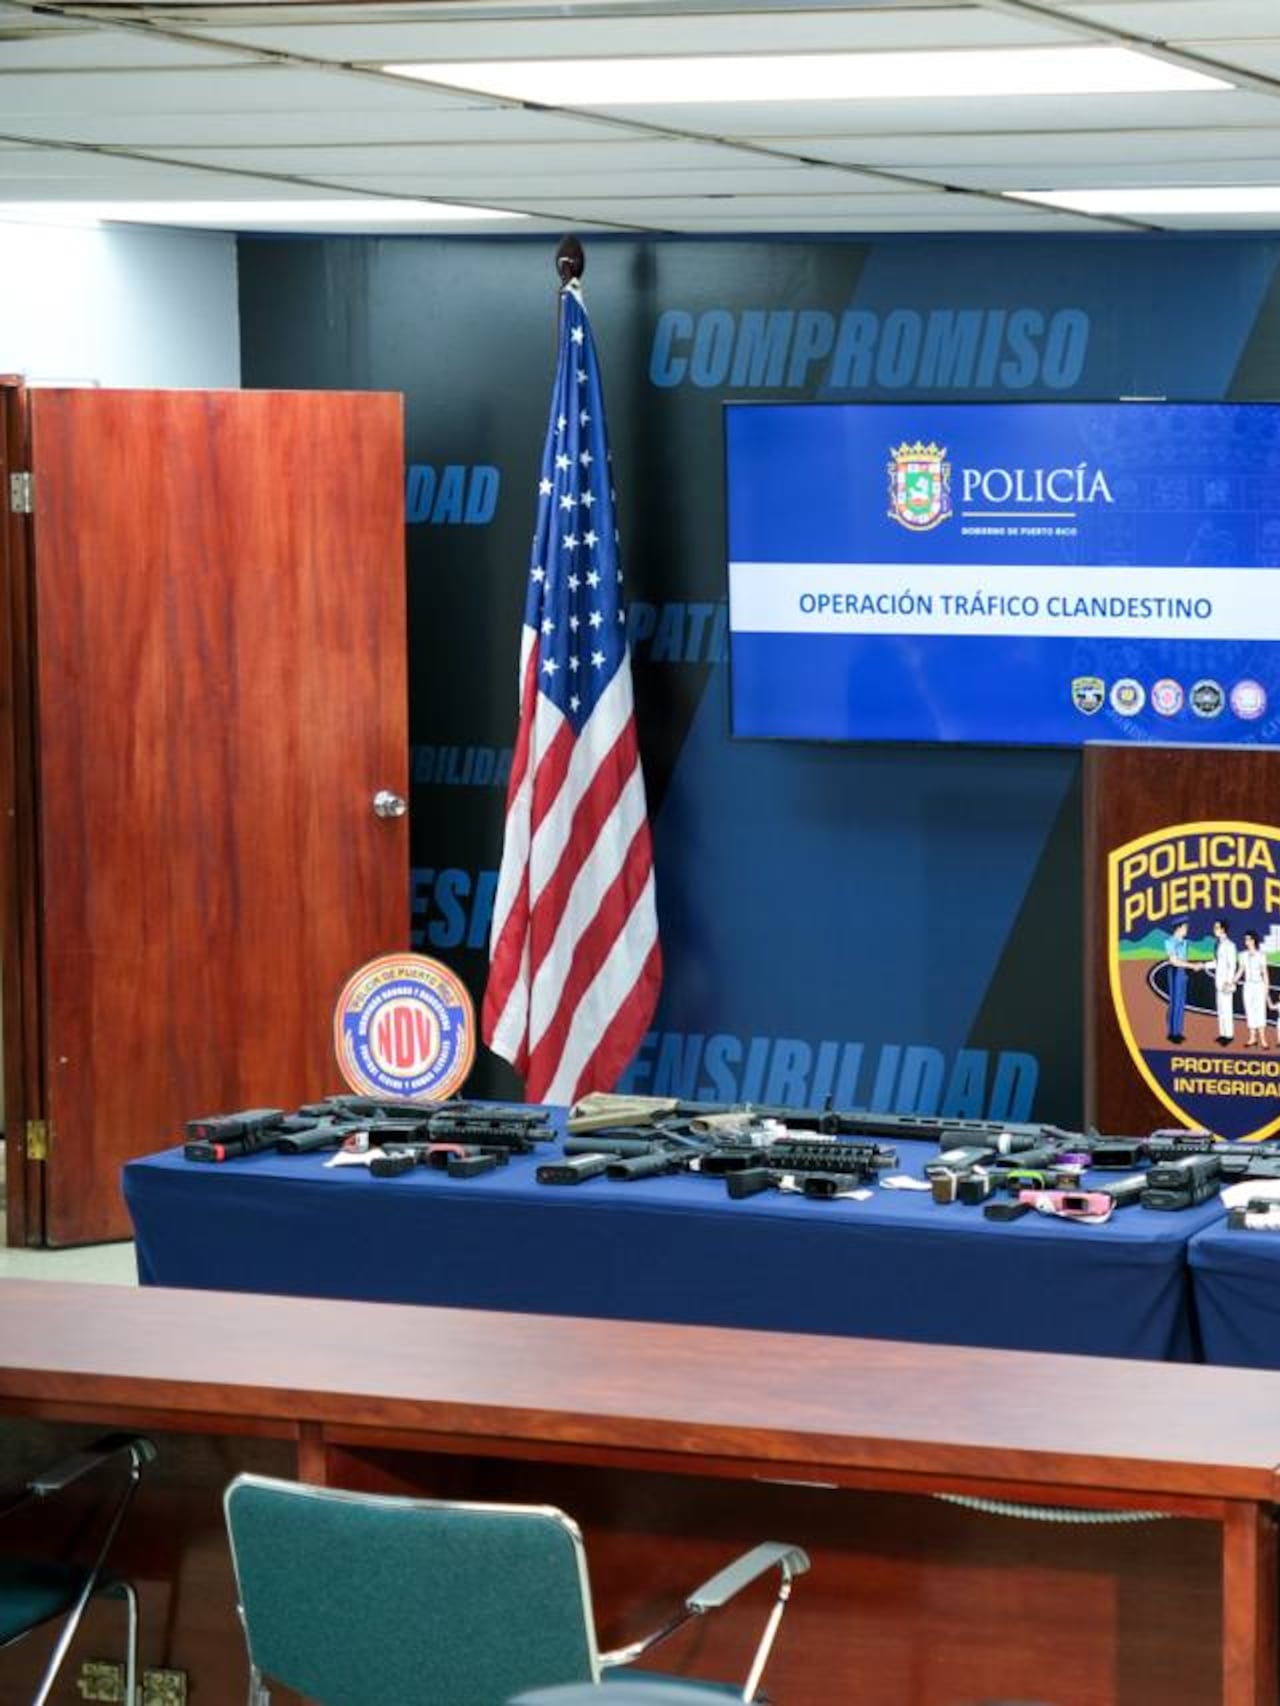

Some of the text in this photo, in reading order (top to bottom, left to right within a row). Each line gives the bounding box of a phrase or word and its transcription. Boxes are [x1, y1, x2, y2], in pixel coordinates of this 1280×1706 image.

[649, 308, 1091, 390] COMPROMISO
[962, 461, 1115, 503] POLICÍA
[1007, 527, 1018, 536] DE
[1020, 528, 1053, 537] PUERTO
[799, 588, 1213, 619] OPERACIÓN TRÁFICO CLANDESTINO
[1122, 835, 1276, 892] POLICIA
[1124, 873, 1254, 932] PUERTO
[377, 1006, 431, 1068] NDV
